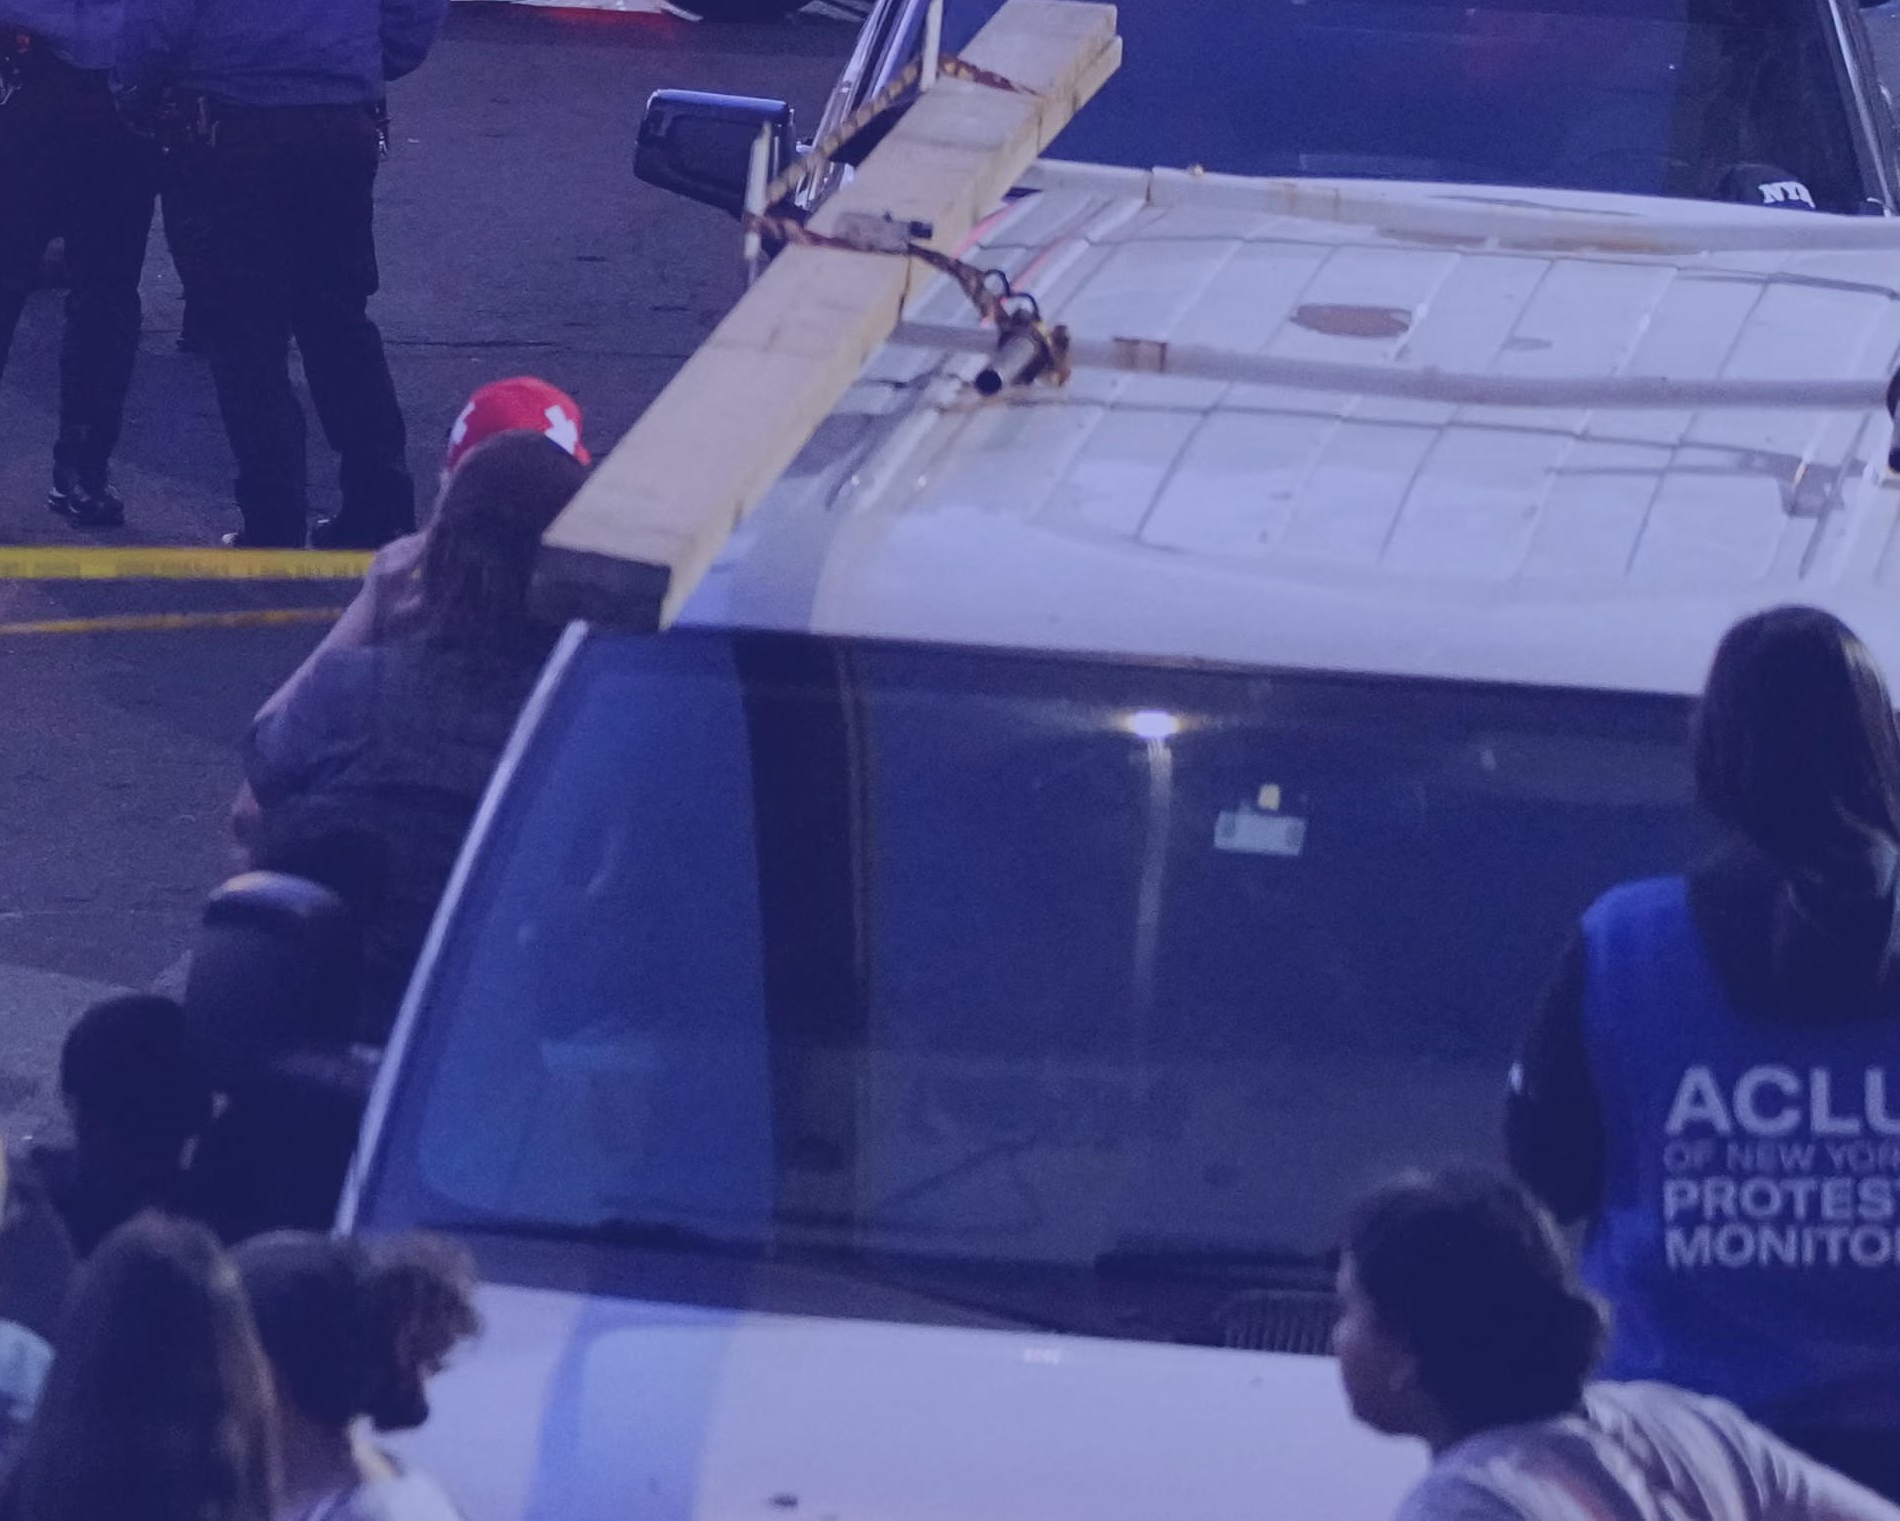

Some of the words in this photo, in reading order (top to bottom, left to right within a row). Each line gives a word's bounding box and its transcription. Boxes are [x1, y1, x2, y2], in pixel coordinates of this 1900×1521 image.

[1663, 1139, 1714, 1172] OF
[1726, 1141, 1816, 1171] NEW
[1662, 1176, 1900, 1221] PROTES
[1664, 1225, 1900, 1269] MONITO
